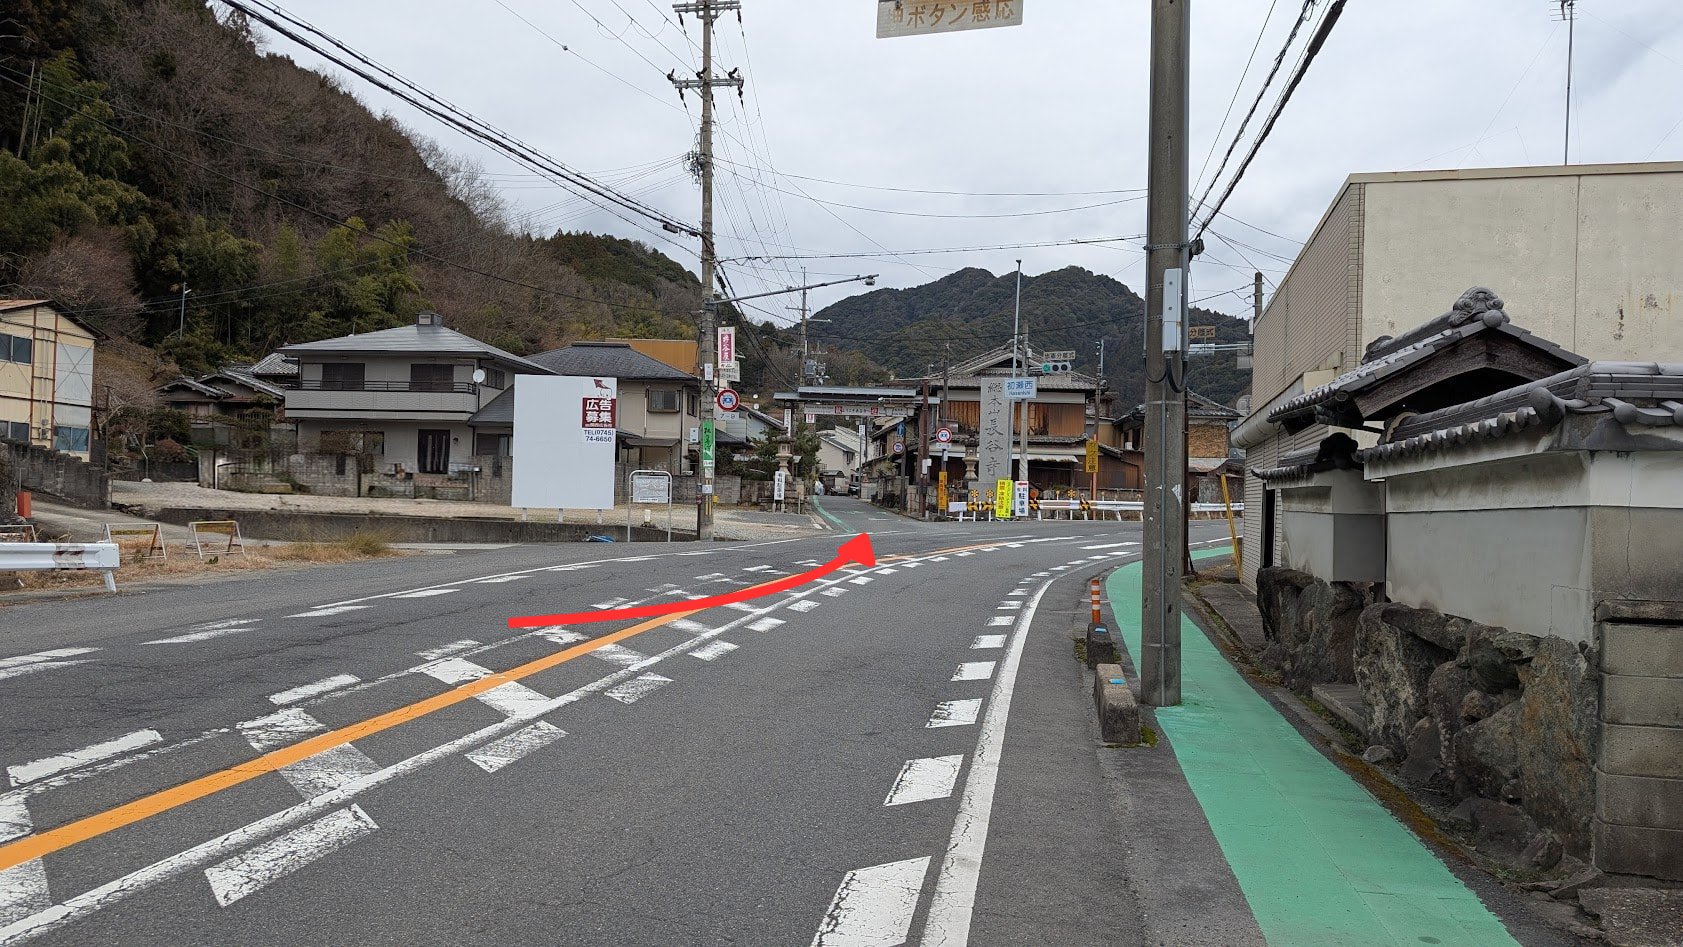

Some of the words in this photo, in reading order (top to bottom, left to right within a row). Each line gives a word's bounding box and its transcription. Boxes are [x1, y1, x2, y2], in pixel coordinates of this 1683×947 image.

[1007, 380, 1034, 391] 初瀬西
[585, 399, 612, 411] 広告
[585, 411, 612, 423] 募集
